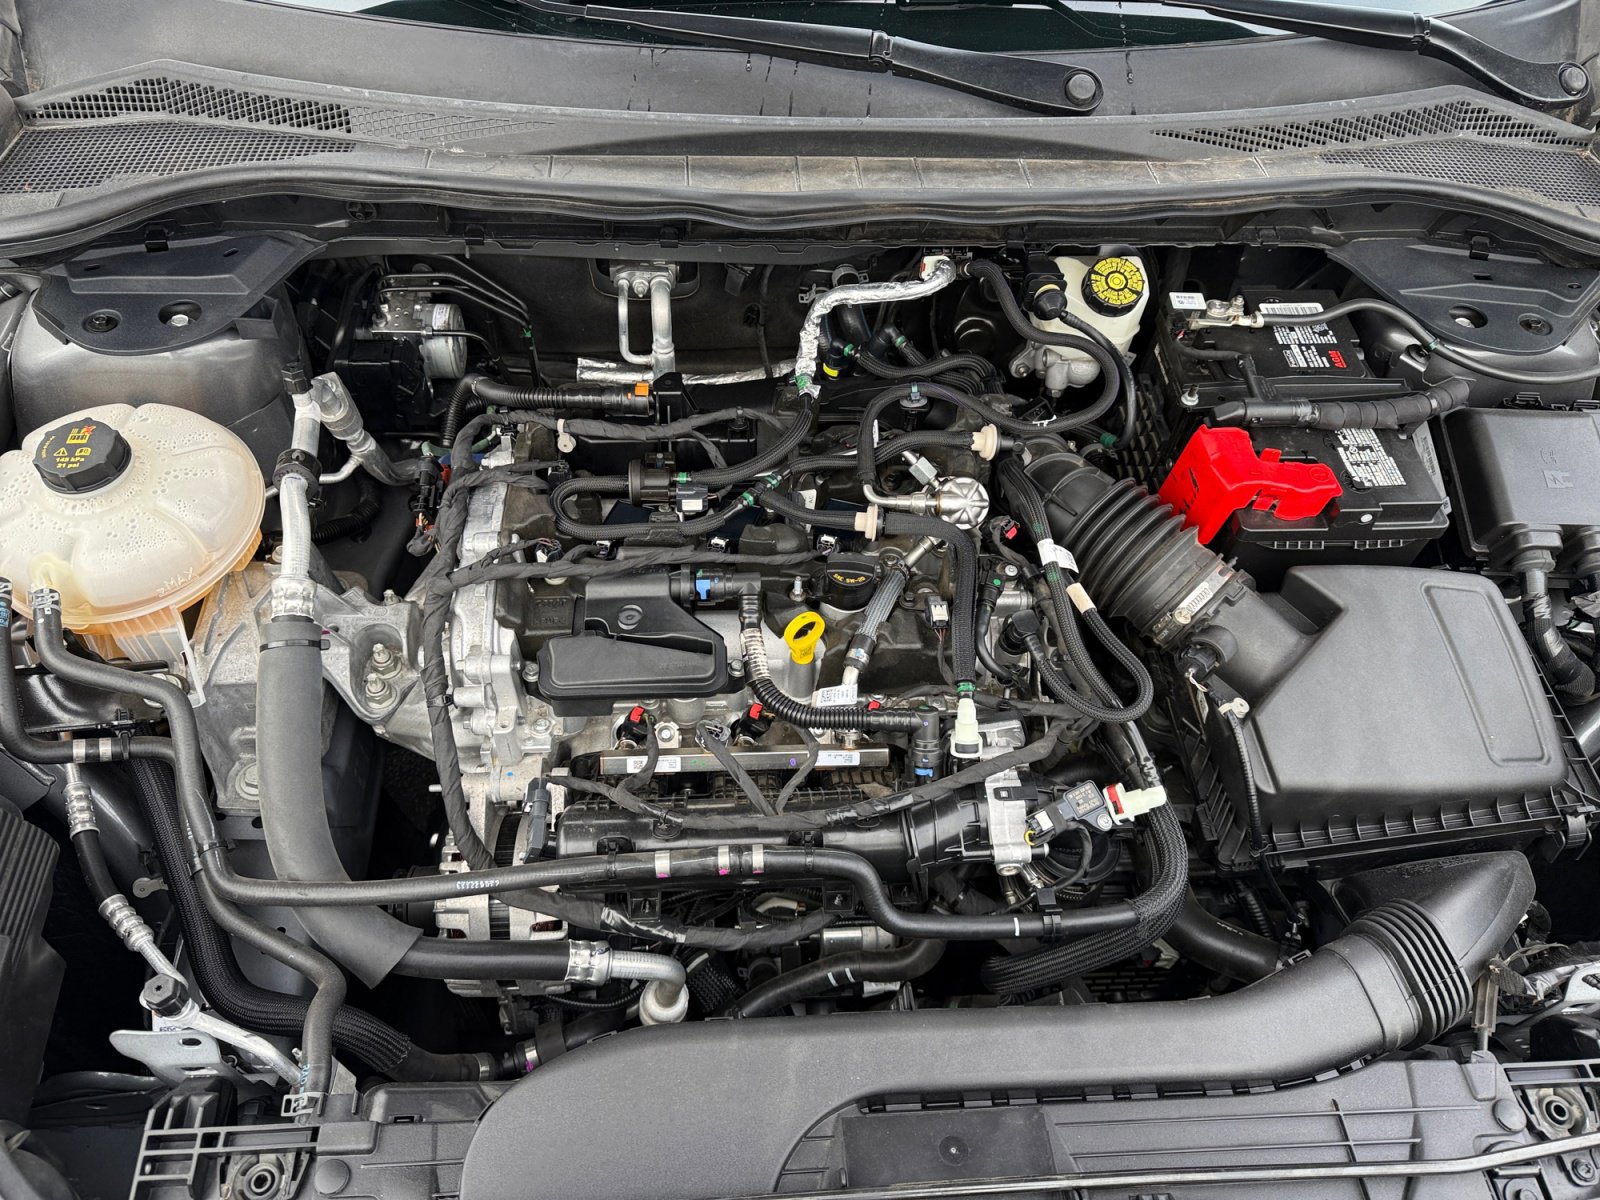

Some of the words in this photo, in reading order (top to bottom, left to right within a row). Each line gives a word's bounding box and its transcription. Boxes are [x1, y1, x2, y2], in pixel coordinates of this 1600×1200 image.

[1328, 350, 1346, 368] AGM
[163, 566, 193, 590] MAX
[832, 573, 844, 582] SAE
